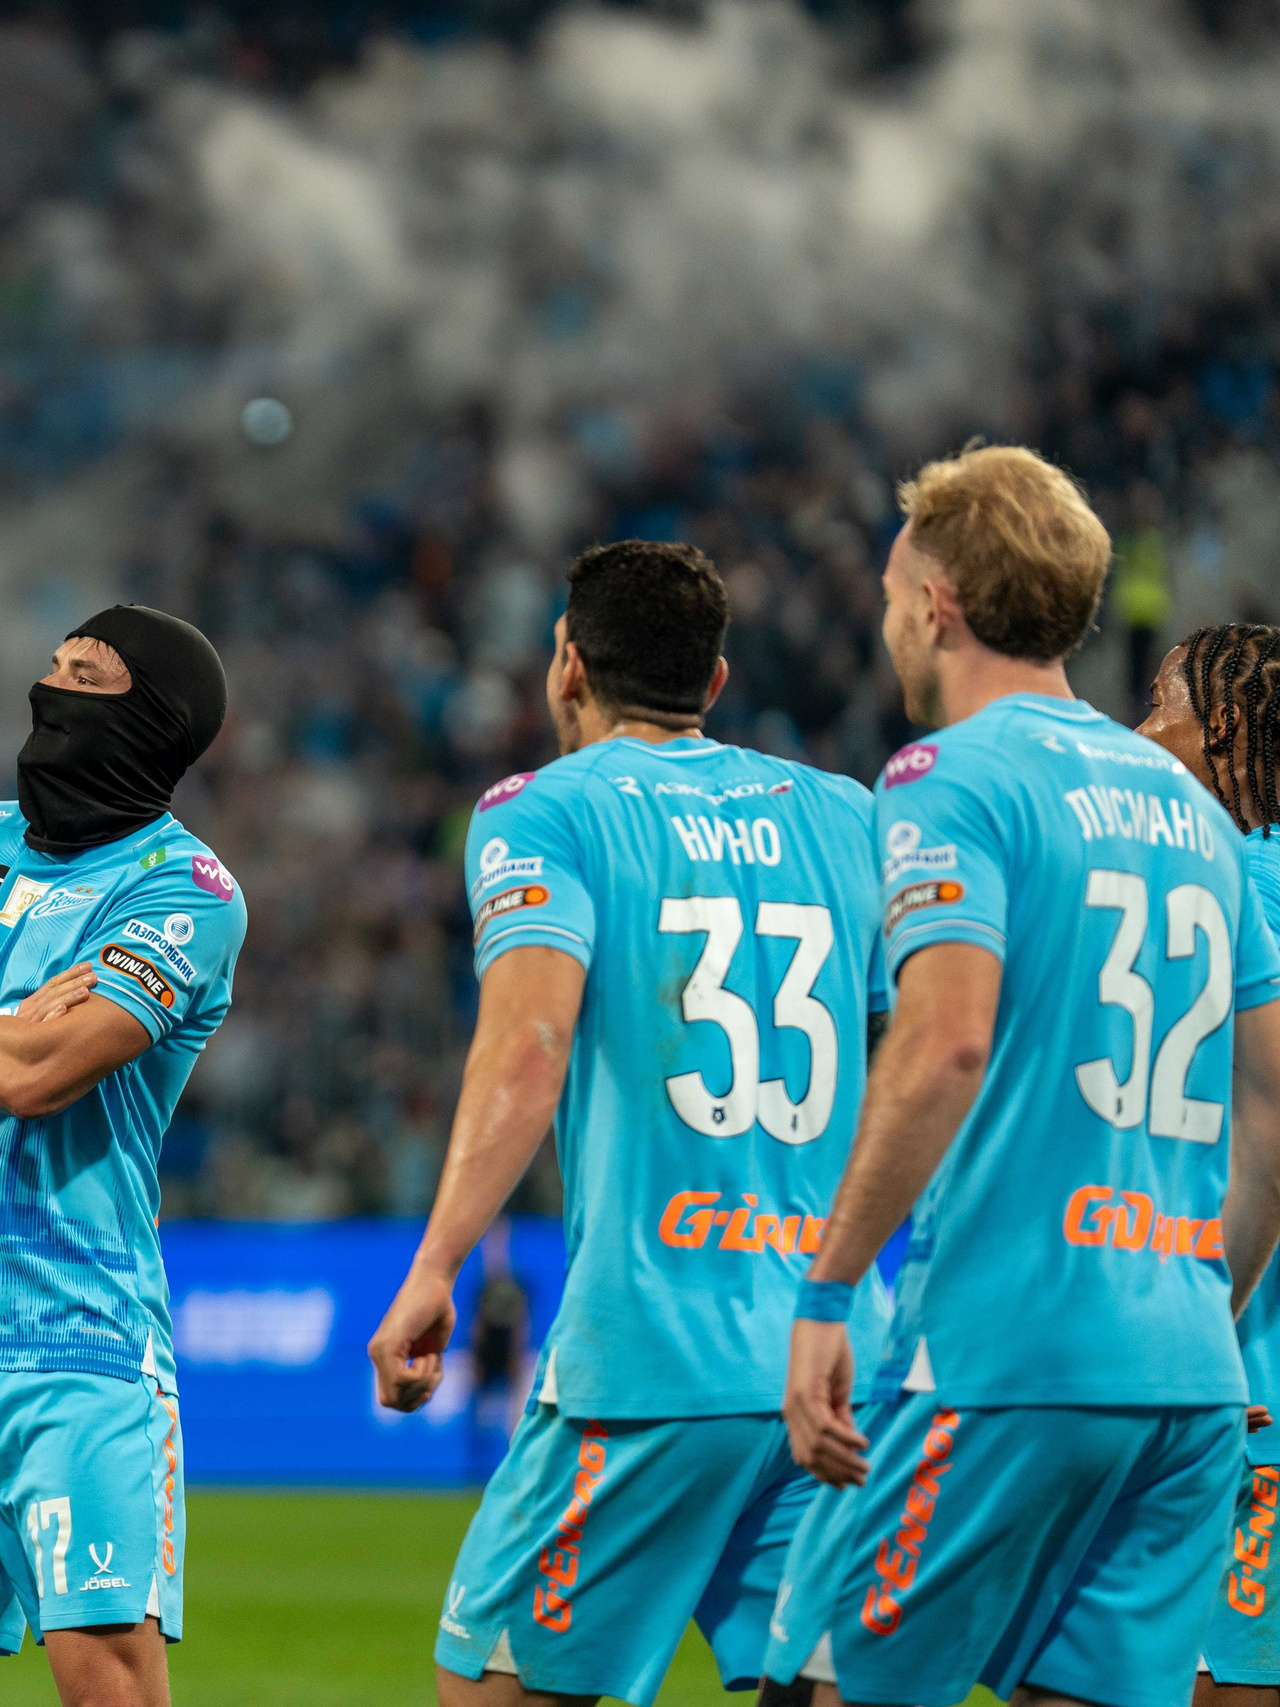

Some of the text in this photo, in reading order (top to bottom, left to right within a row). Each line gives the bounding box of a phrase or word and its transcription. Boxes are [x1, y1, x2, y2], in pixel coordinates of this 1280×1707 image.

[484, 775, 526, 801] wb
[194, 861, 233, 891] wb
[106, 949, 165, 995] WINLINE
[127, 921, 194, 982] ГАЗПРОМБАНК
[658, 895, 839, 1146] 33
[1075, 868, 1234, 1145] 32
[26, 1495, 73, 1600] 17
[79, 1576, 132, 1592] JÖGEL
